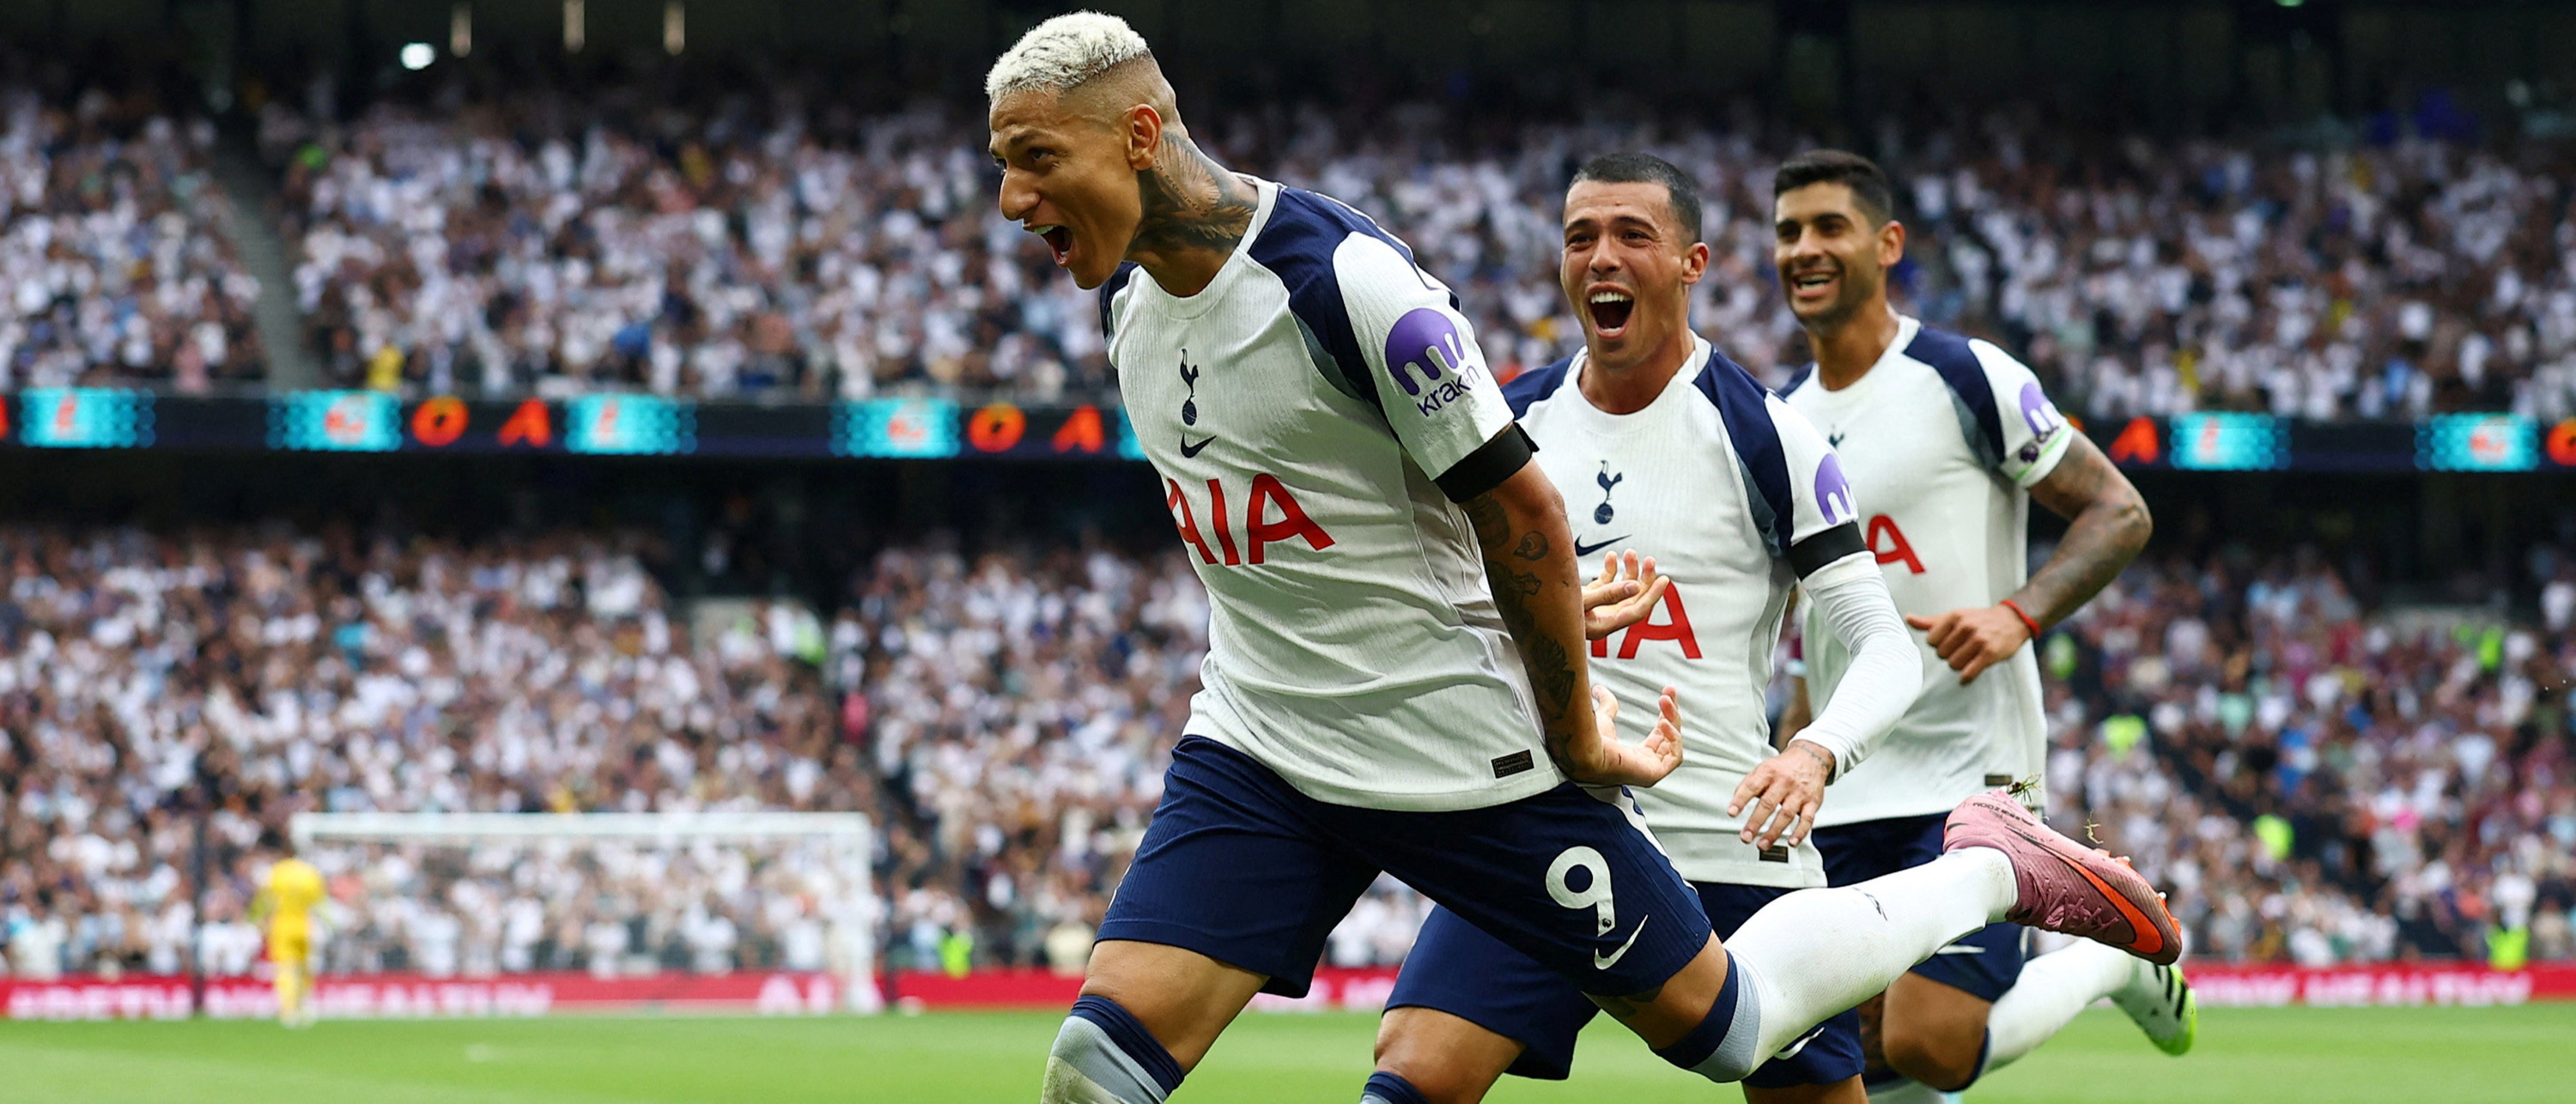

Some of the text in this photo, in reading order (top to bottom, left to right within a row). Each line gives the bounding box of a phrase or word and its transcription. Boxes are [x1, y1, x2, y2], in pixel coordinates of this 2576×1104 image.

[1416, 364, 1481, 417] krakn
[1166, 472, 1336, 567] AIA
[1546, 845, 1616, 937] 9
